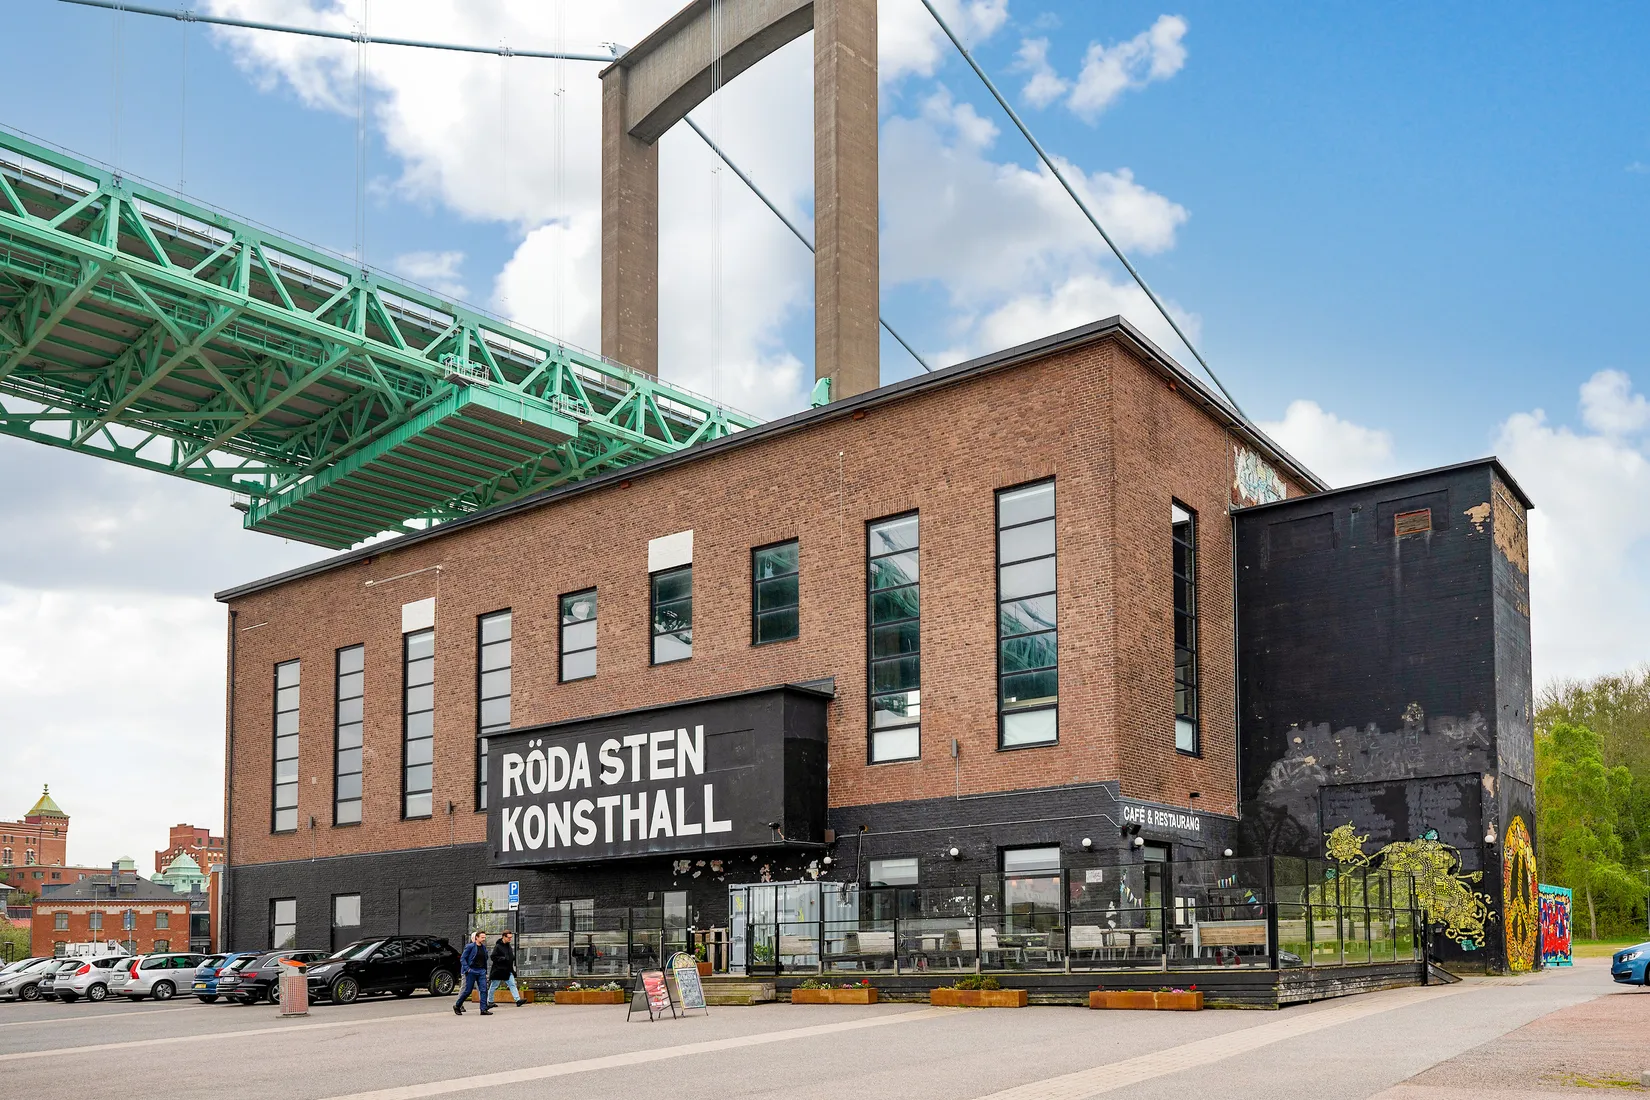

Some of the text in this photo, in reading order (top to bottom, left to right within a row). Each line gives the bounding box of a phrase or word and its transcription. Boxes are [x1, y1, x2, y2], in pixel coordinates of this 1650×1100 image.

[502, 725, 704, 798] RÖDA STEN
[502, 784, 732, 852] KONSTHALL
[1124, 806, 1200, 831] CAFÉ & RESTAURANG
[511, 883, 517, 894] P
